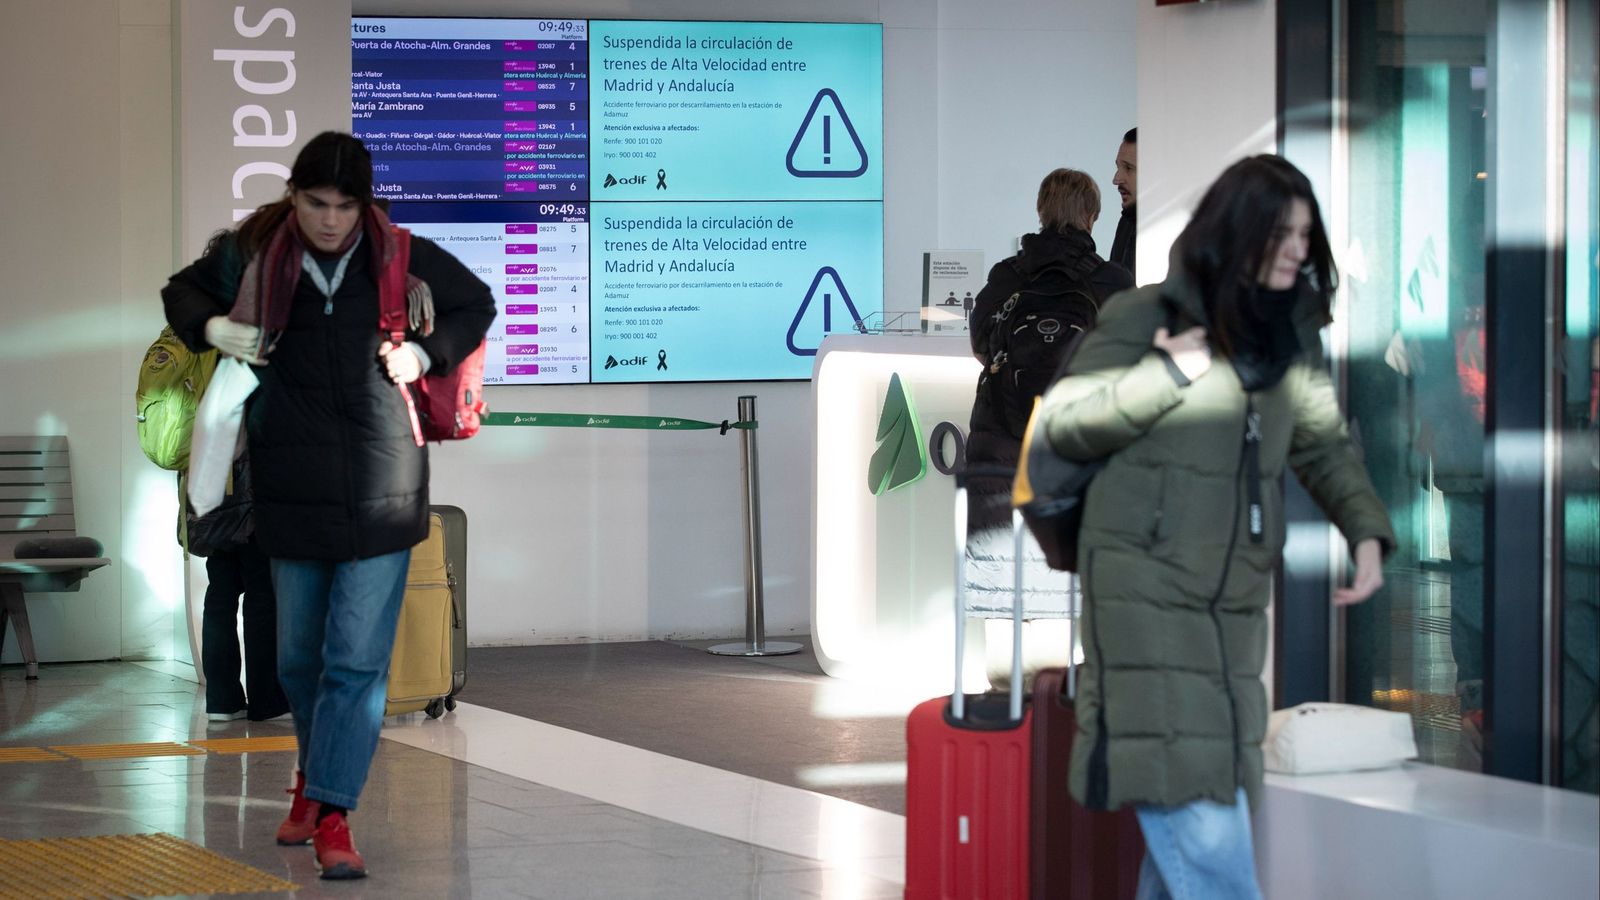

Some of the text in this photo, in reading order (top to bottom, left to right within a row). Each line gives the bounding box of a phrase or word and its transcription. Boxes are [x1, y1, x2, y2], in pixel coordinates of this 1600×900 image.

[381, 41, 491, 49] de Atocha-Alm. Grandes
[604, 36, 792, 51] Suspendida la circulación de
[604, 58, 806, 71] trenes de Alta Velocidad entre
[605, 78, 734, 94] Madrid y Andalucía
[352, 102, 424, 110] María Zambrano
[619, 175, 646, 184] adif
[570, 183, 576, 191] 6
[604, 216, 793, 232] Suspendida la circulación de
[604, 238, 806, 251] trenes de Alta Velocidad entre
[606, 259, 734, 275] Madrid y Andalucía
[571, 325, 577, 333] 6
[620, 356, 647, 366] adif
[571, 365, 577, 373] 5
